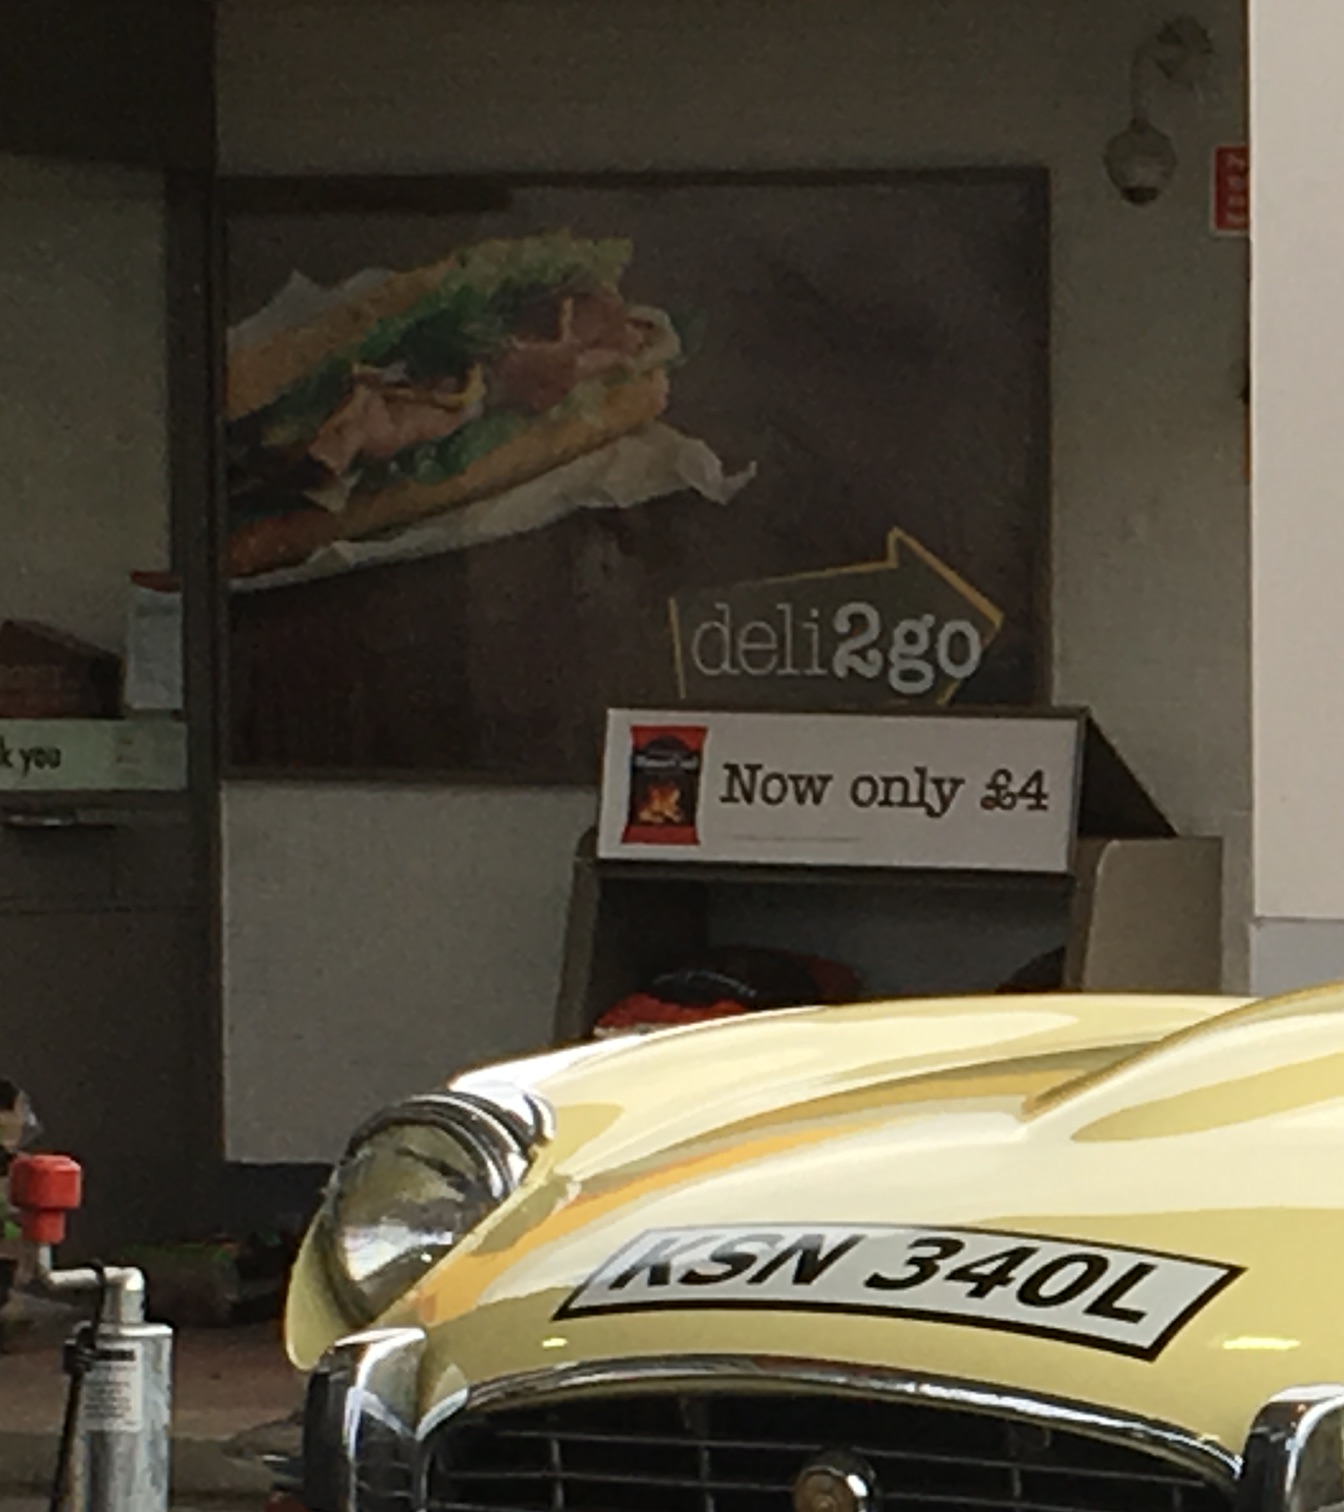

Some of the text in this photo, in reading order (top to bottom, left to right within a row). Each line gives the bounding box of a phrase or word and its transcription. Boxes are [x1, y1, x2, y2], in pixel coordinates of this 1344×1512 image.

[691, 601, 983, 693] deli2go
[719, 762, 1049, 818] Now only £4
[606, 1229, 1158, 1325] KSN 340L
